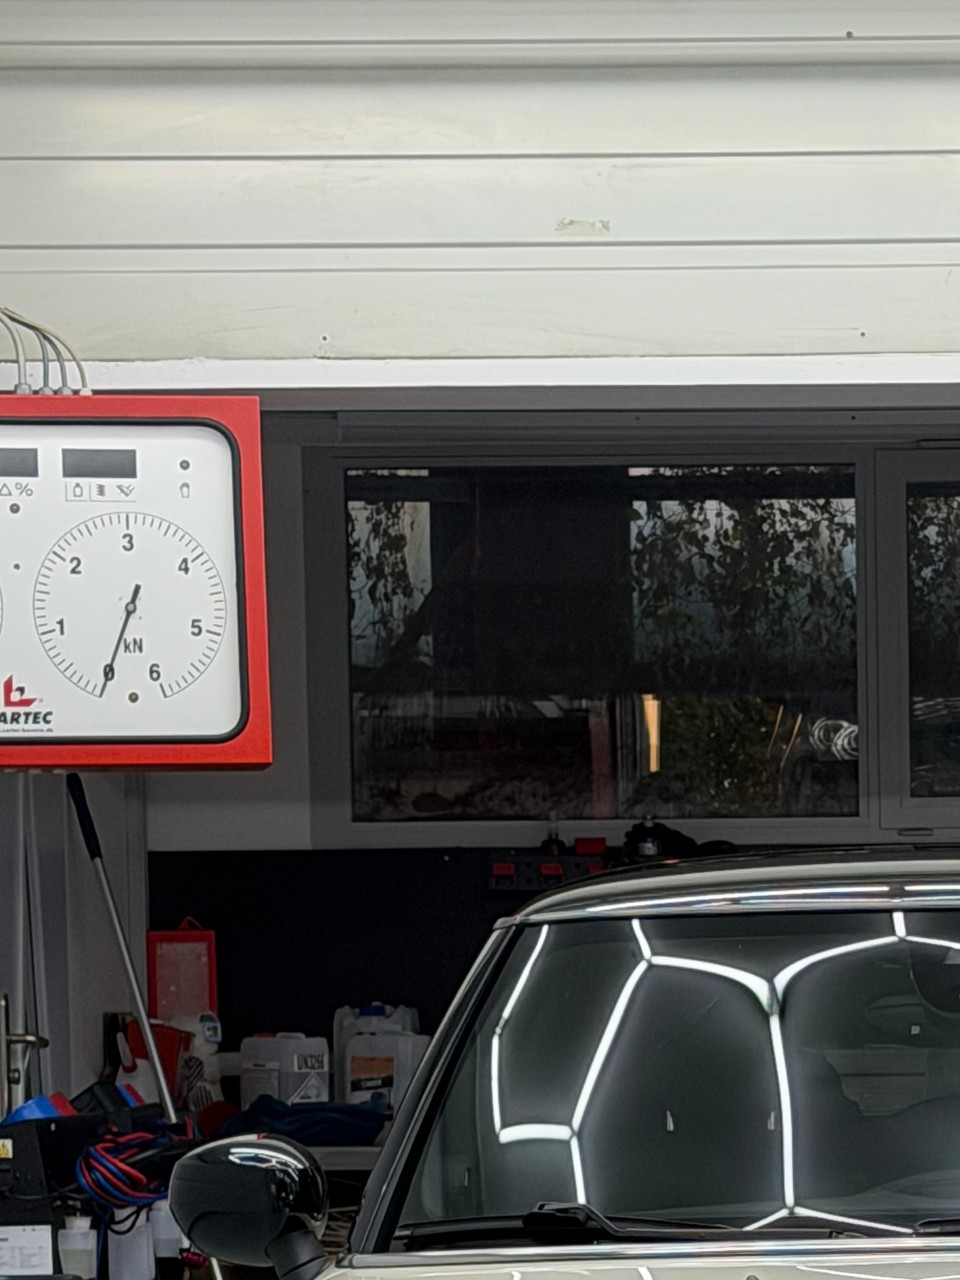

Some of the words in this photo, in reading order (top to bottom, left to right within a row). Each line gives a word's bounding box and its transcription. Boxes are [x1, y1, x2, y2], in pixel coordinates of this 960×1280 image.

[121, 533, 135, 552] 3
[69, 556, 82, 575] 2
[177, 557, 190, 576] 4
[56, 618, 65, 636] 1
[190, 618, 203, 637] 5
[123, 637, 144, 654] kN
[103, 663, 115, 682] 0
[149, 663, 161, 682] 6
